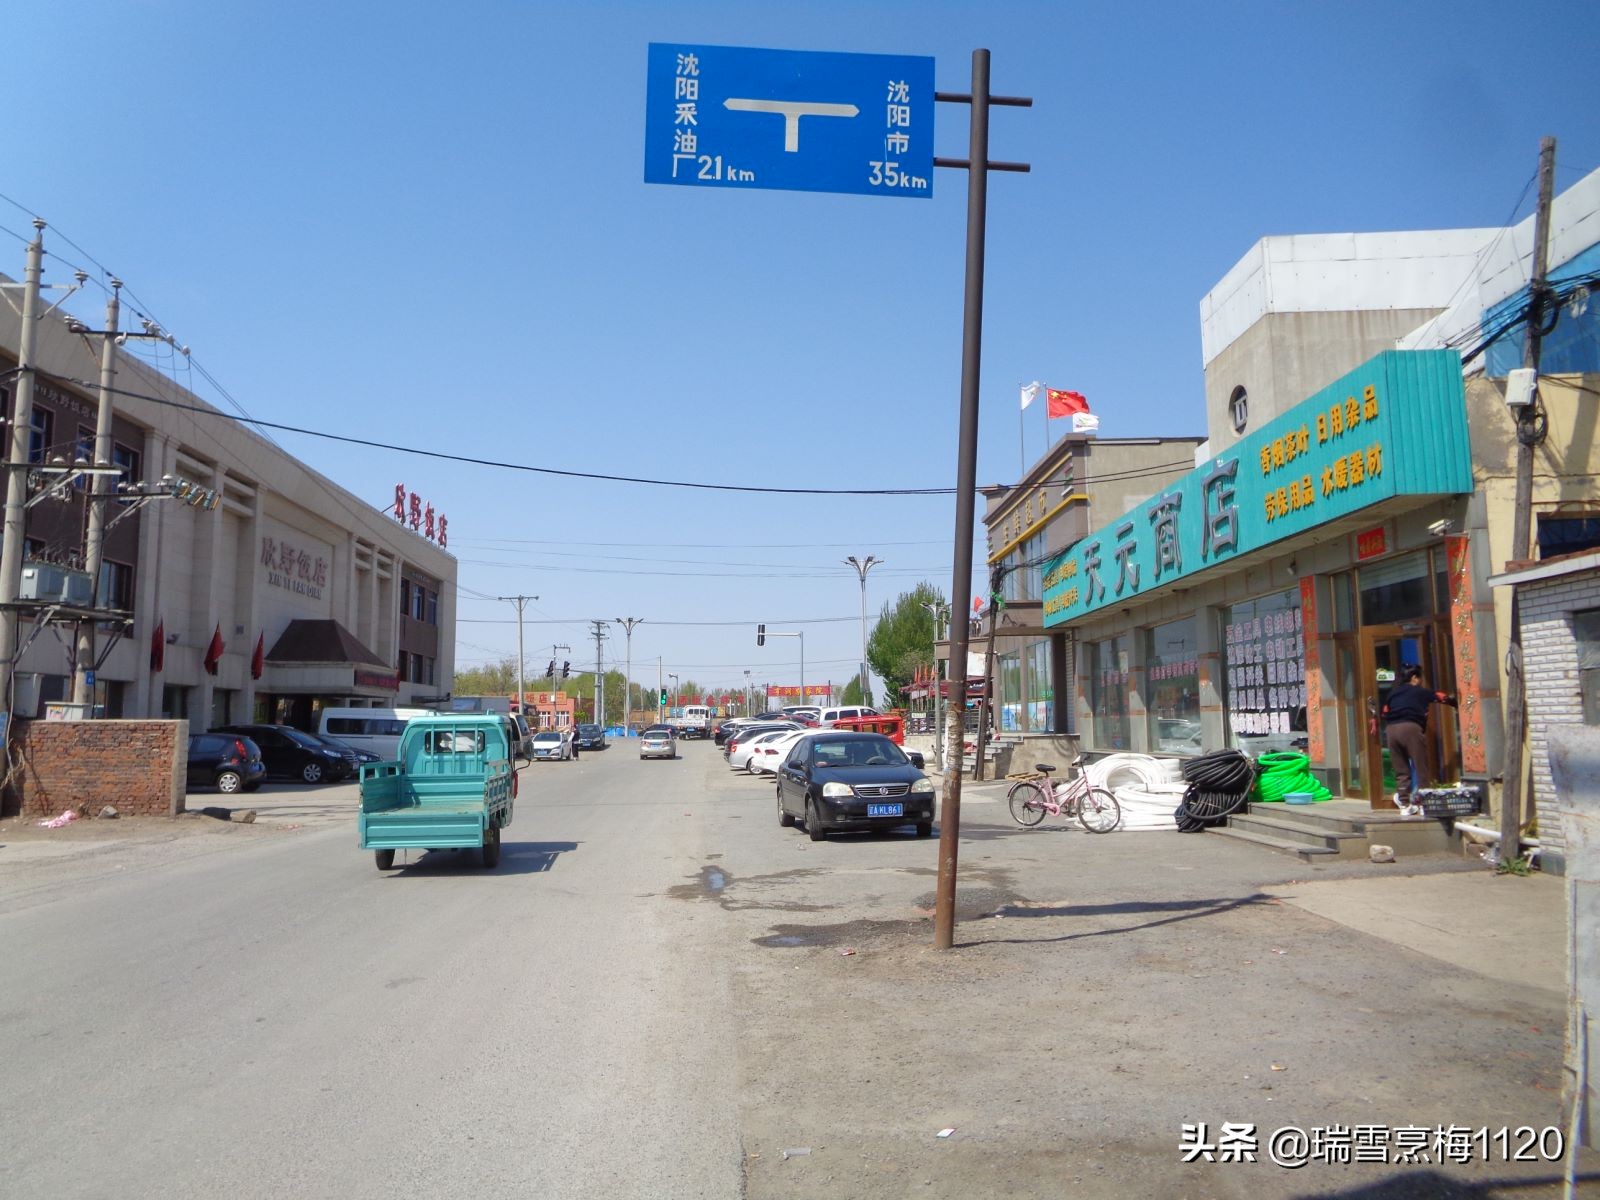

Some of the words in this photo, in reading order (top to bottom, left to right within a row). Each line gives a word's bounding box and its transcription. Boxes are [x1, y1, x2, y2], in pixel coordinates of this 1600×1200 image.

[672, 53, 699, 178] 沈阳采油厂
[886, 80, 910, 155] 沈阳市
[1083, 457, 1239, 604] 天元商店
